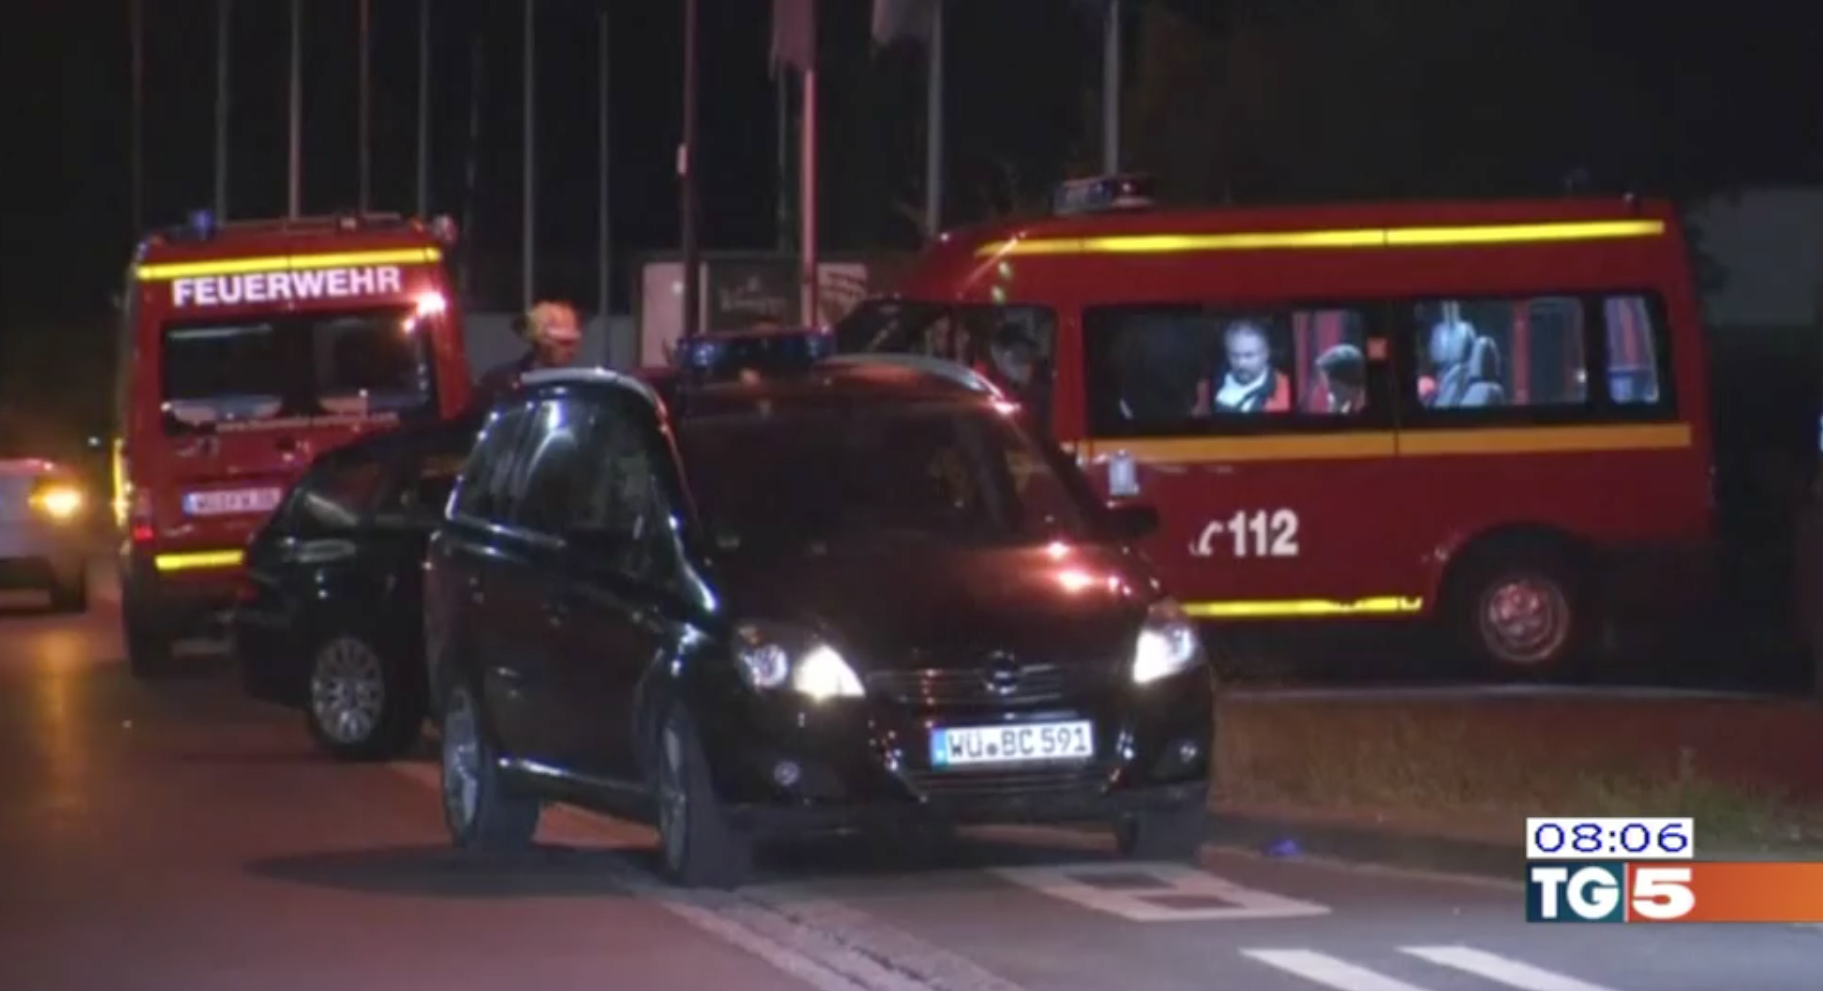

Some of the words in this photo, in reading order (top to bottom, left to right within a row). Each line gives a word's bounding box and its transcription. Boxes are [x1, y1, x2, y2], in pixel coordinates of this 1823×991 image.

[172, 265, 401, 307] FEUERWEHR
[1227, 507, 1300, 557] 112
[1040, 724, 1089, 754] 591
